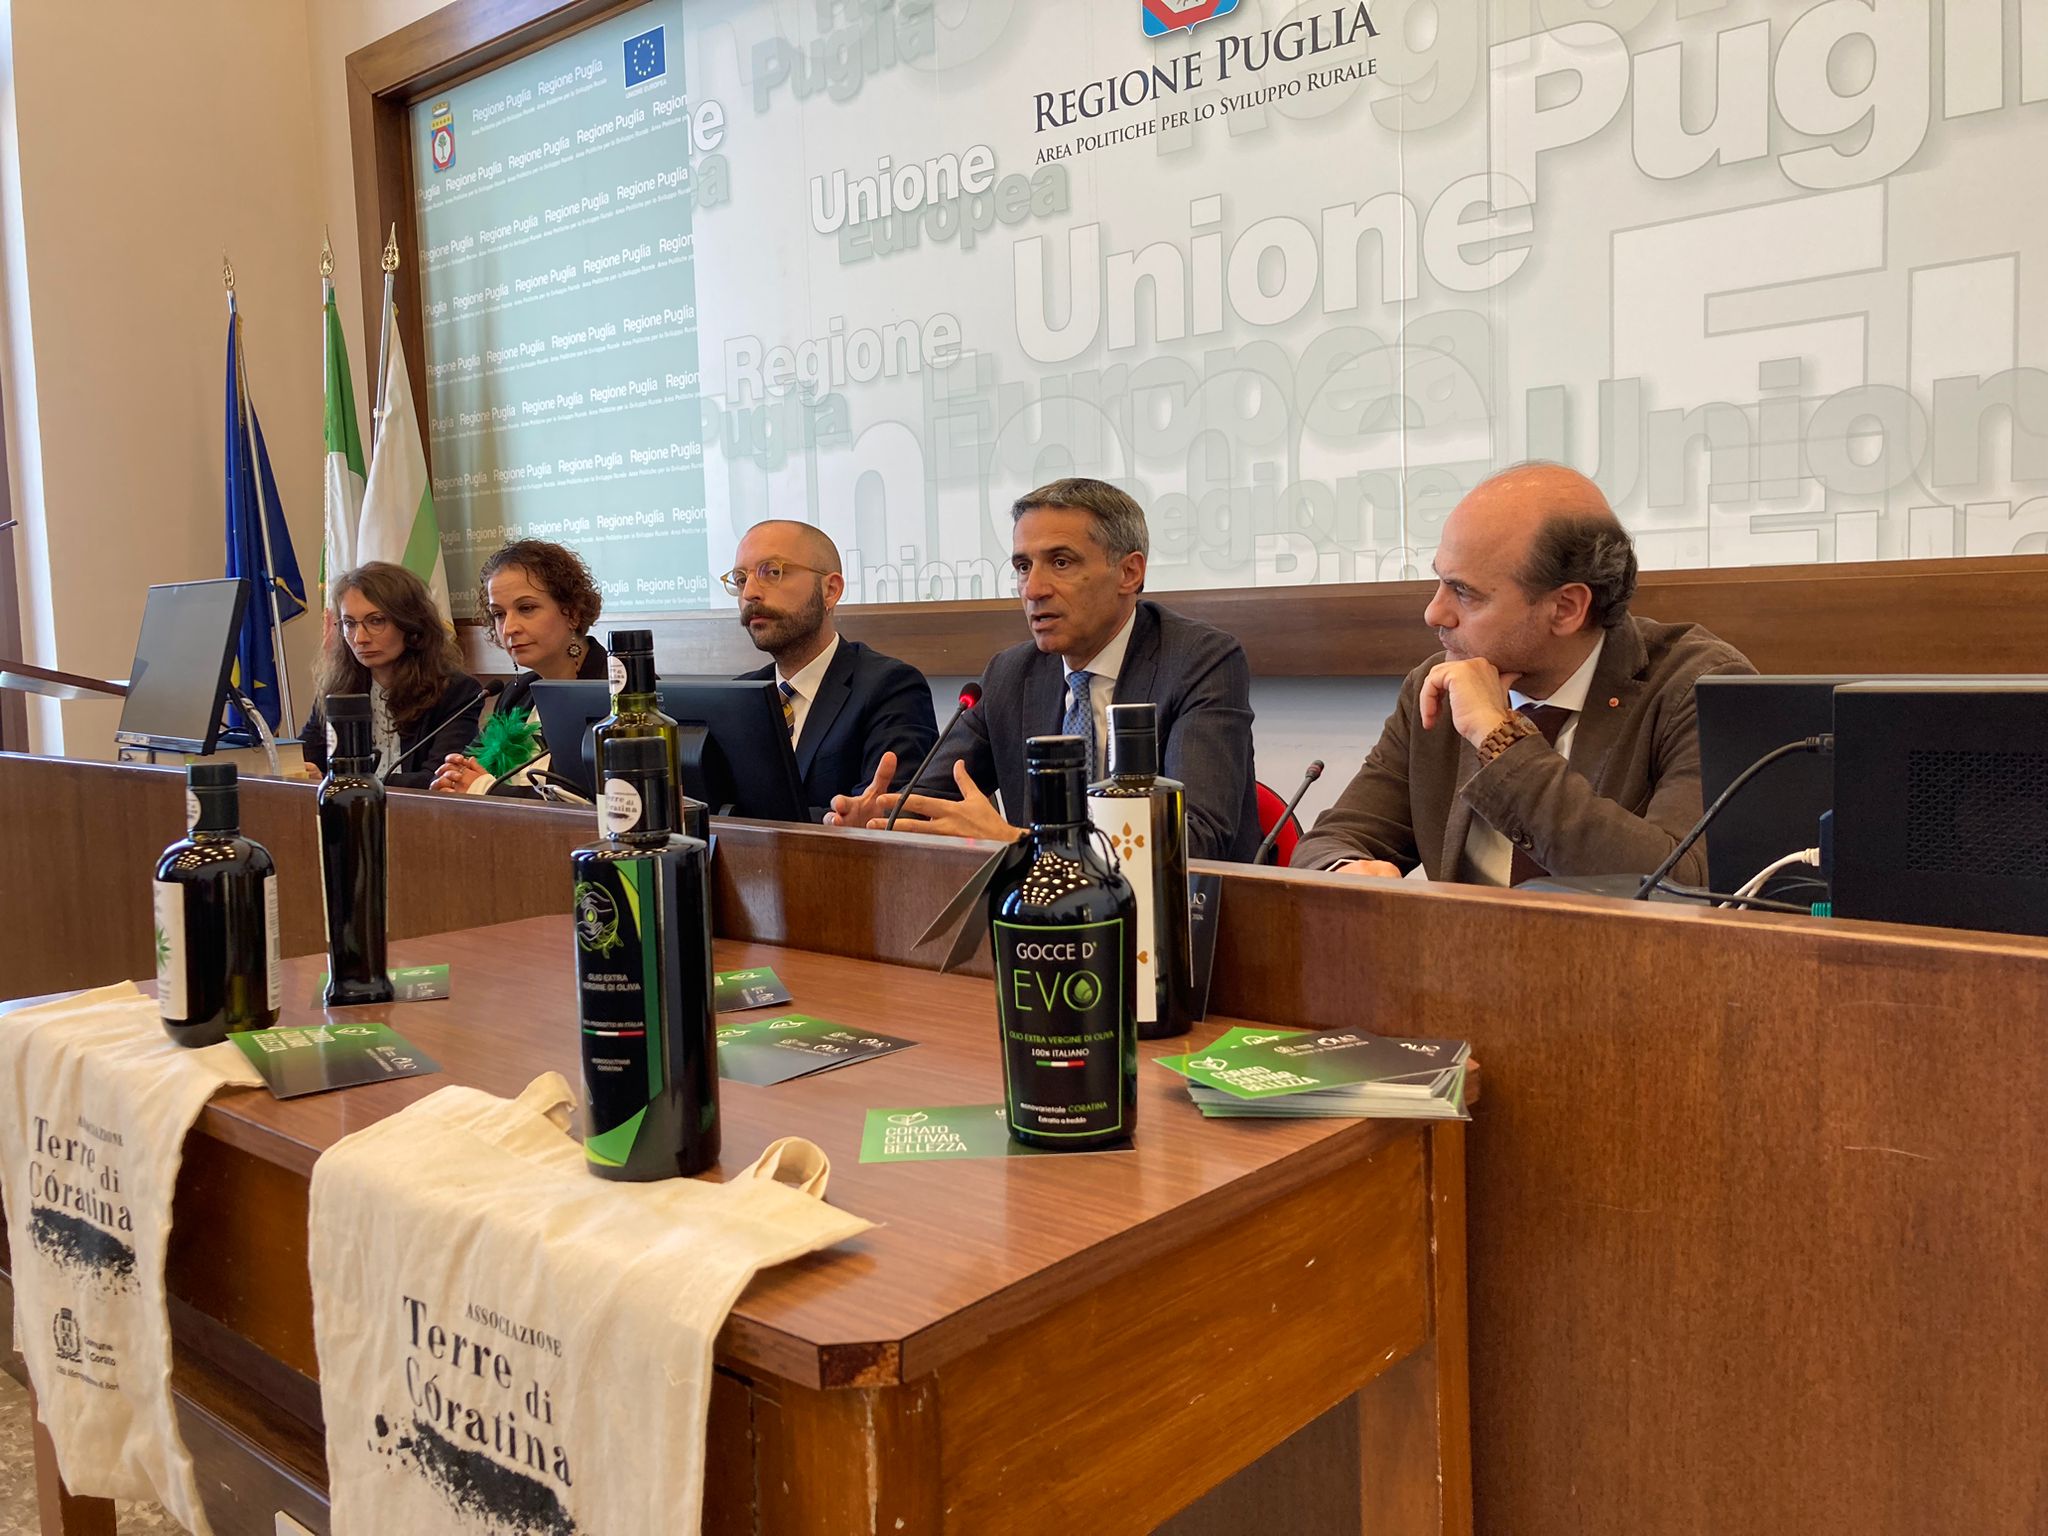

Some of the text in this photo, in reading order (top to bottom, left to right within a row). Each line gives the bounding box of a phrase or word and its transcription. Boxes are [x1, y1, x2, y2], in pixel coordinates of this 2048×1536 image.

[472, 100, 505, 122] Regione
[506, 88, 532, 108] Puglia
[538, 72, 573, 95] Regione
[574, 59, 603, 80] Puglia
[1033, 1, 1380, 134] REGIONE PUGLIA
[1035, 58, 1377, 165] AREA POLITICHE PER LO SVILUPPO RURALE
[445, 171, 477, 191] Regione
[477, 160, 503, 180] Puglia
[508, 148, 542, 168] Regione
[543, 136, 570, 156] Puglia
[576, 121, 614, 144] Regione
[615, 108, 645, 130] Puglia
[450, 235, 474, 253] Puglia
[480, 224, 512, 243] Regione
[513, 215, 538, 232] Puglia
[544, 203, 580, 223] Regione
[581, 192, 609, 212] Puglia
[616, 178, 655, 200] Regione
[657, 166, 688, 187] Puglia
[810, 144, 995, 233] Unione
[838, 163, 1070, 265] Europea
[453, 291, 484, 310] Regione
[485, 283, 509, 301] Puglia
[515, 274, 549, 293] Regione
[550, 265, 576, 283] Puglia
[583, 254, 621, 275] Regione
[622, 243, 651, 263] Puglia
[1013, 172, 1535, 363] Unione
[457, 354, 480, 371] Puglia
[486, 346, 519, 364] Regione
[520, 339, 545, 357] Puglia
[551, 331, 586, 349] Regione
[588, 322, 616, 341] Puglia
[623, 313, 662, 333] Regione
[664, 304, 695, 324] Puglia
[724, 312, 962, 407] Regione
[491, 404, 516, 421] Puglia
[522, 397, 555, 415] Regione
[556, 391, 583, 409] Puglia
[590, 385, 627, 403] Regione
[629, 377, 658, 396] Puglia
[464, 472, 487, 488] Puglia
[493, 467, 525, 483] Regione
[526, 462, 552, 478] Puglia
[558, 457, 593, 475] Regione
[594, 452, 623, 470] Puglia
[630, 447, 669, 466] Regione
[670, 441, 701, 460] Puglia
[498, 523, 522, 539] Puglia
[528, 519, 562, 537] Regione
[563, 517, 590, 534] Puglia
[596, 513, 633, 531] Regione
[635, 508, 664, 527] Puglia
[637, 578, 675, 595] Regione
[677, 575, 708, 593] Puglia
[1016, 941, 1099, 960] GOCCE D'
[616, 983, 641, 991] OLIVA
[1013, 969, 1102, 1012] EVO
[1024, 1033, 1047, 1044] EXTRA
[1048, 1035, 1082, 1044] VERGINE
[1084, 1034, 1092, 1042] DI
[1052, 1048, 1089, 1057] ITALIANO
[885, 1124, 949, 1136] CORATO
[1067, 1101, 1107, 1113] CORATINA
[34, 1115, 120, 1193] Terre di
[883, 1142, 968, 1155] BELLEZZA
[884, 1133, 961, 1144] CULTIVAR
[465, 1302, 562, 1358] ASSOCIAZIONE
[403, 1295, 554, 1425] Terre di
[406, 1356, 573, 1487] Córatina
